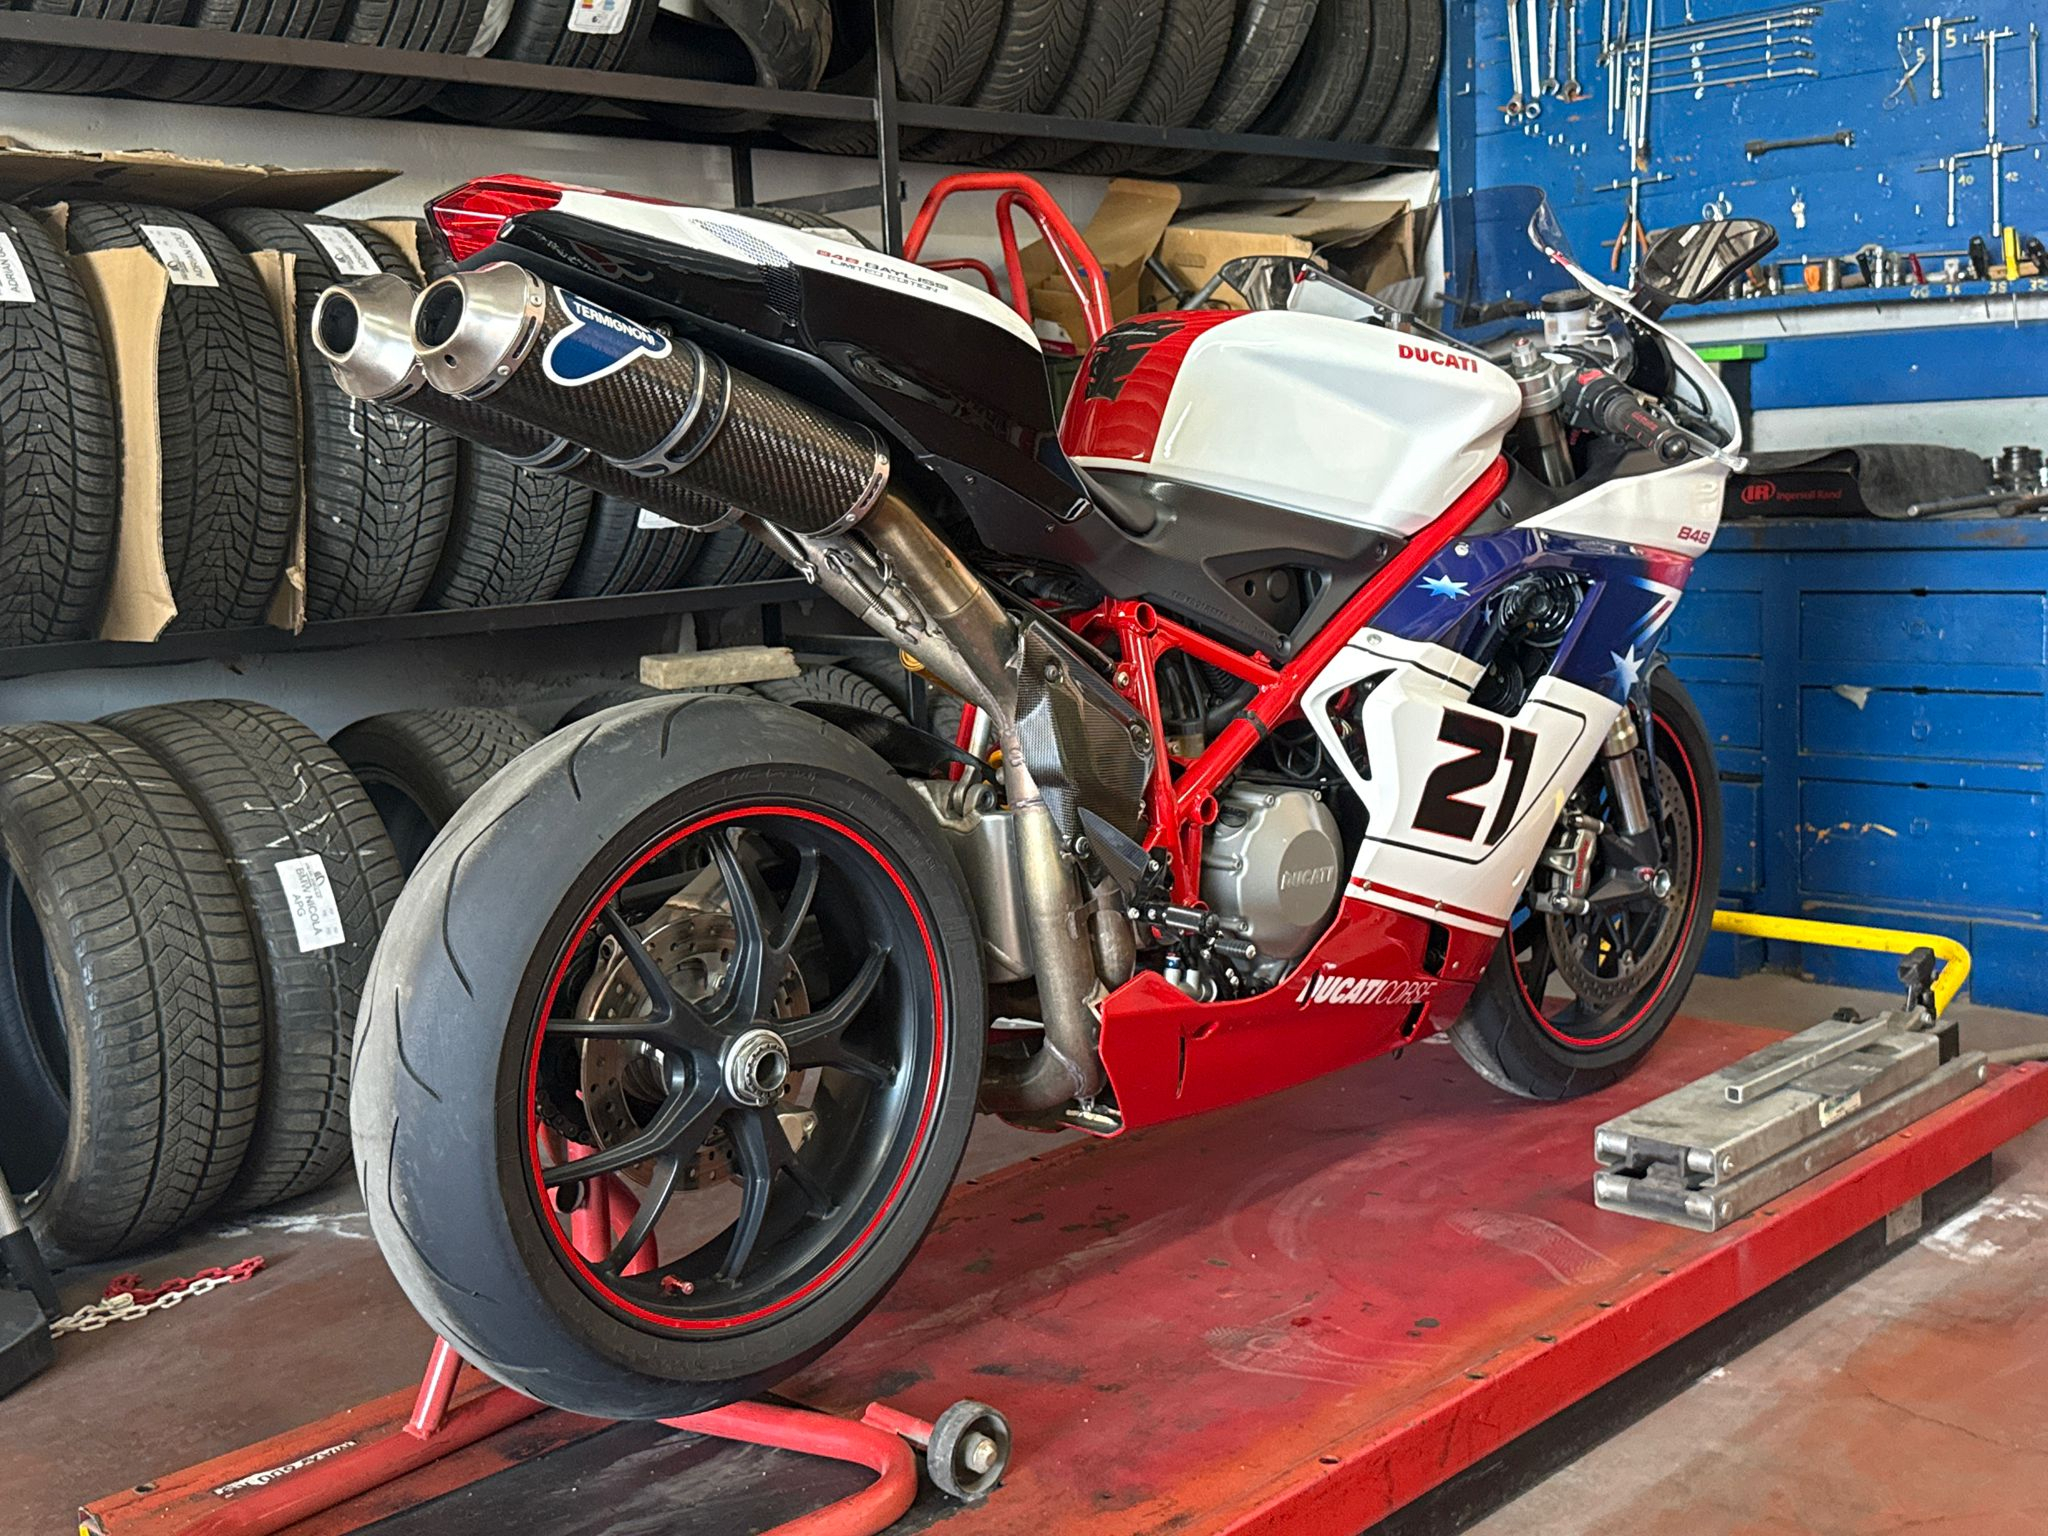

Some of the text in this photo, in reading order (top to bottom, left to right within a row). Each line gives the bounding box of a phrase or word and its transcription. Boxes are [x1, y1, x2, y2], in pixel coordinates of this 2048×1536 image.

[1945, 28, 1957, 48] 5
[1, 259, 21, 293] ADRIAN
[184, 249, 205, 279] ADRIAN
[573, 301, 656, 346] TERMIGNONI
[1398, 344, 1478, 374] DUCATI
[1677, 526, 1711, 545] 848
[1411, 706, 1538, 846] 21
[1281, 865, 1335, 891] DUCATI
[292, 894, 307, 917] APG
[296, 867, 312, 893] BMW
[304, 895, 323, 935] NICOLA
